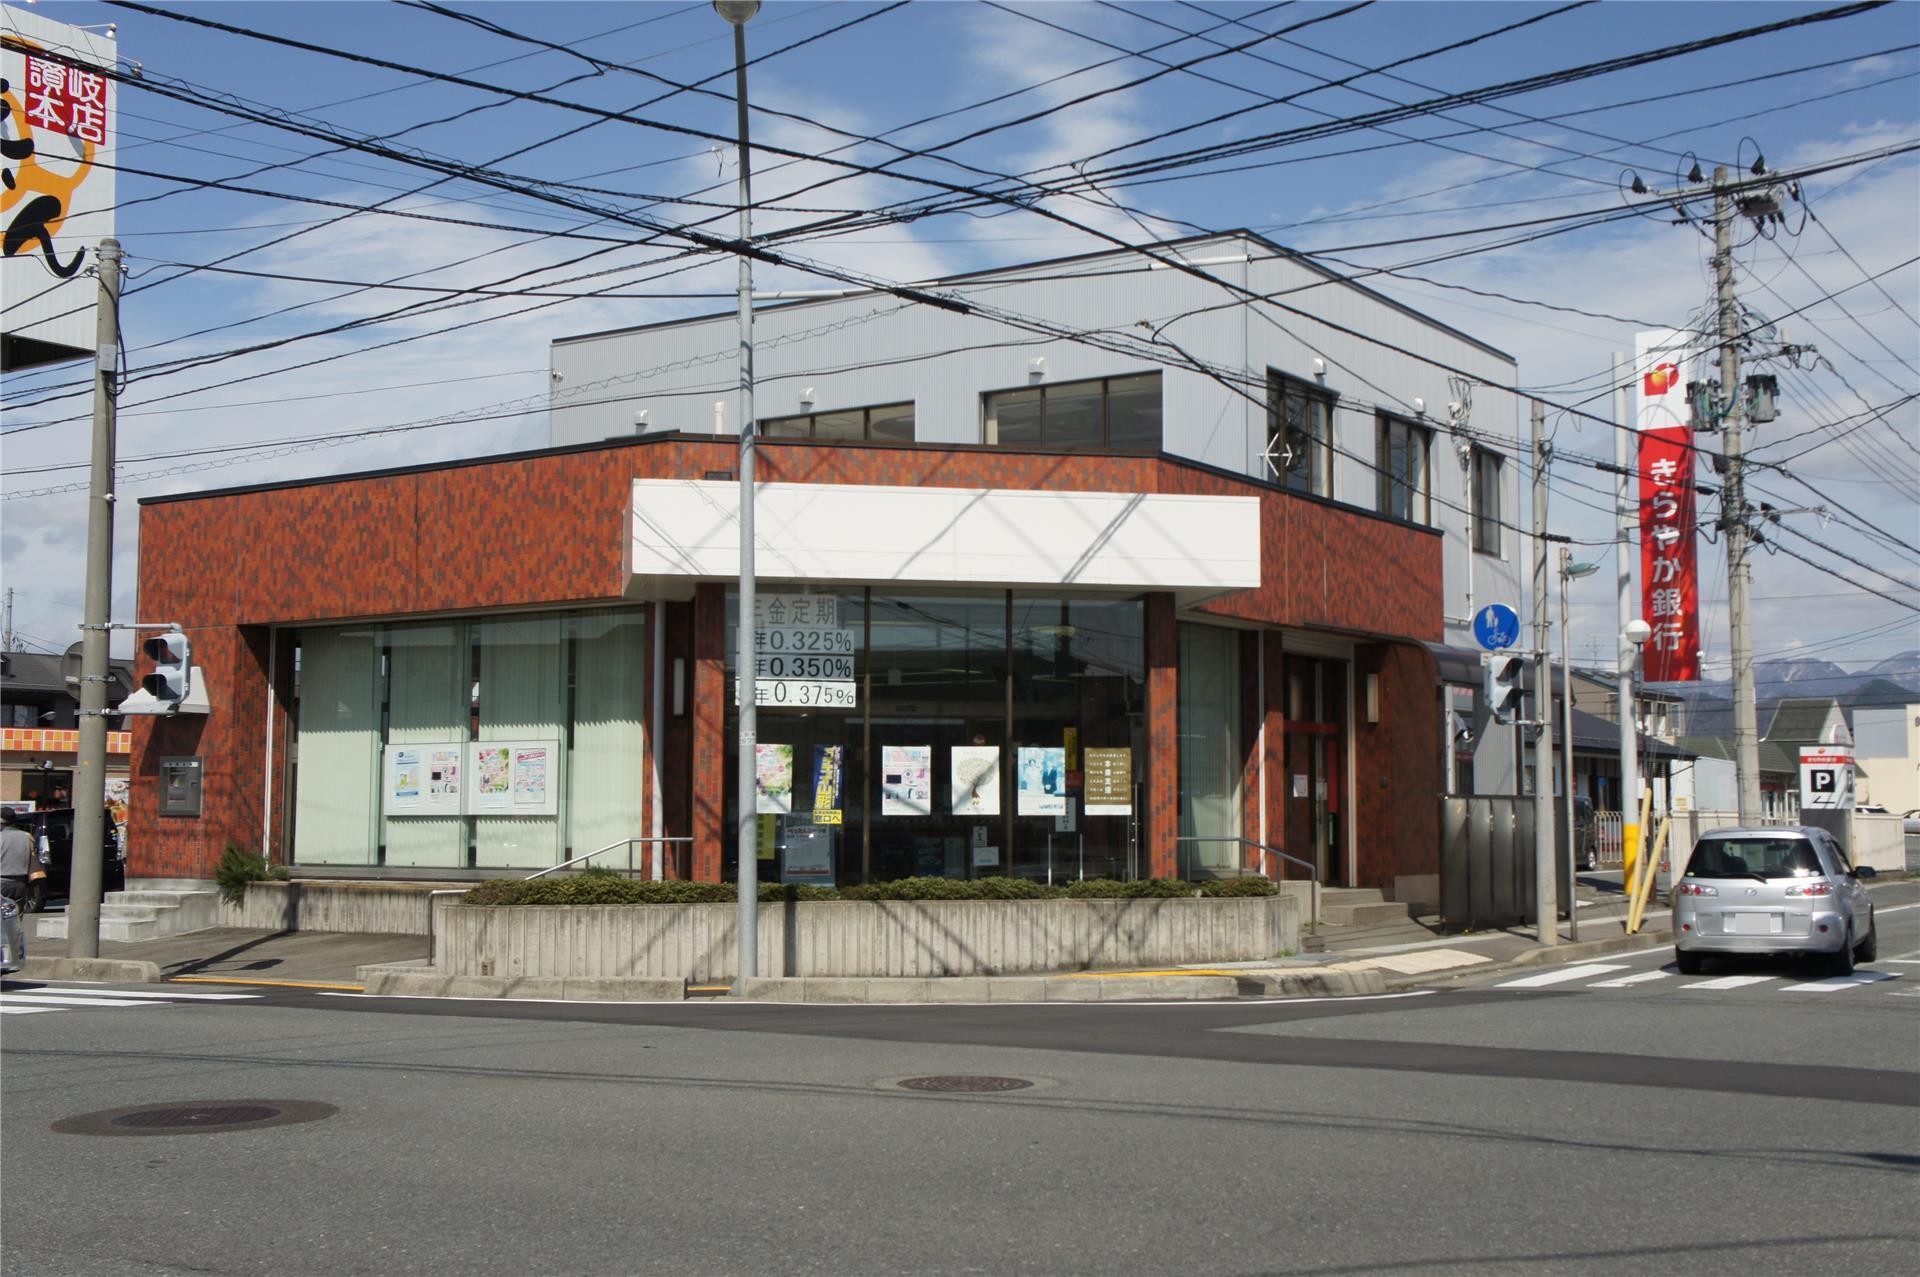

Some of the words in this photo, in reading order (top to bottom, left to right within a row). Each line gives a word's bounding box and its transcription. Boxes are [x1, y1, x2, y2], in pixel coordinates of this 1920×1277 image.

[28, 92, 103, 141] 本店
[1651, 458, 1683, 651] きらやか銀行
[1816, 772, 1830, 790] P
